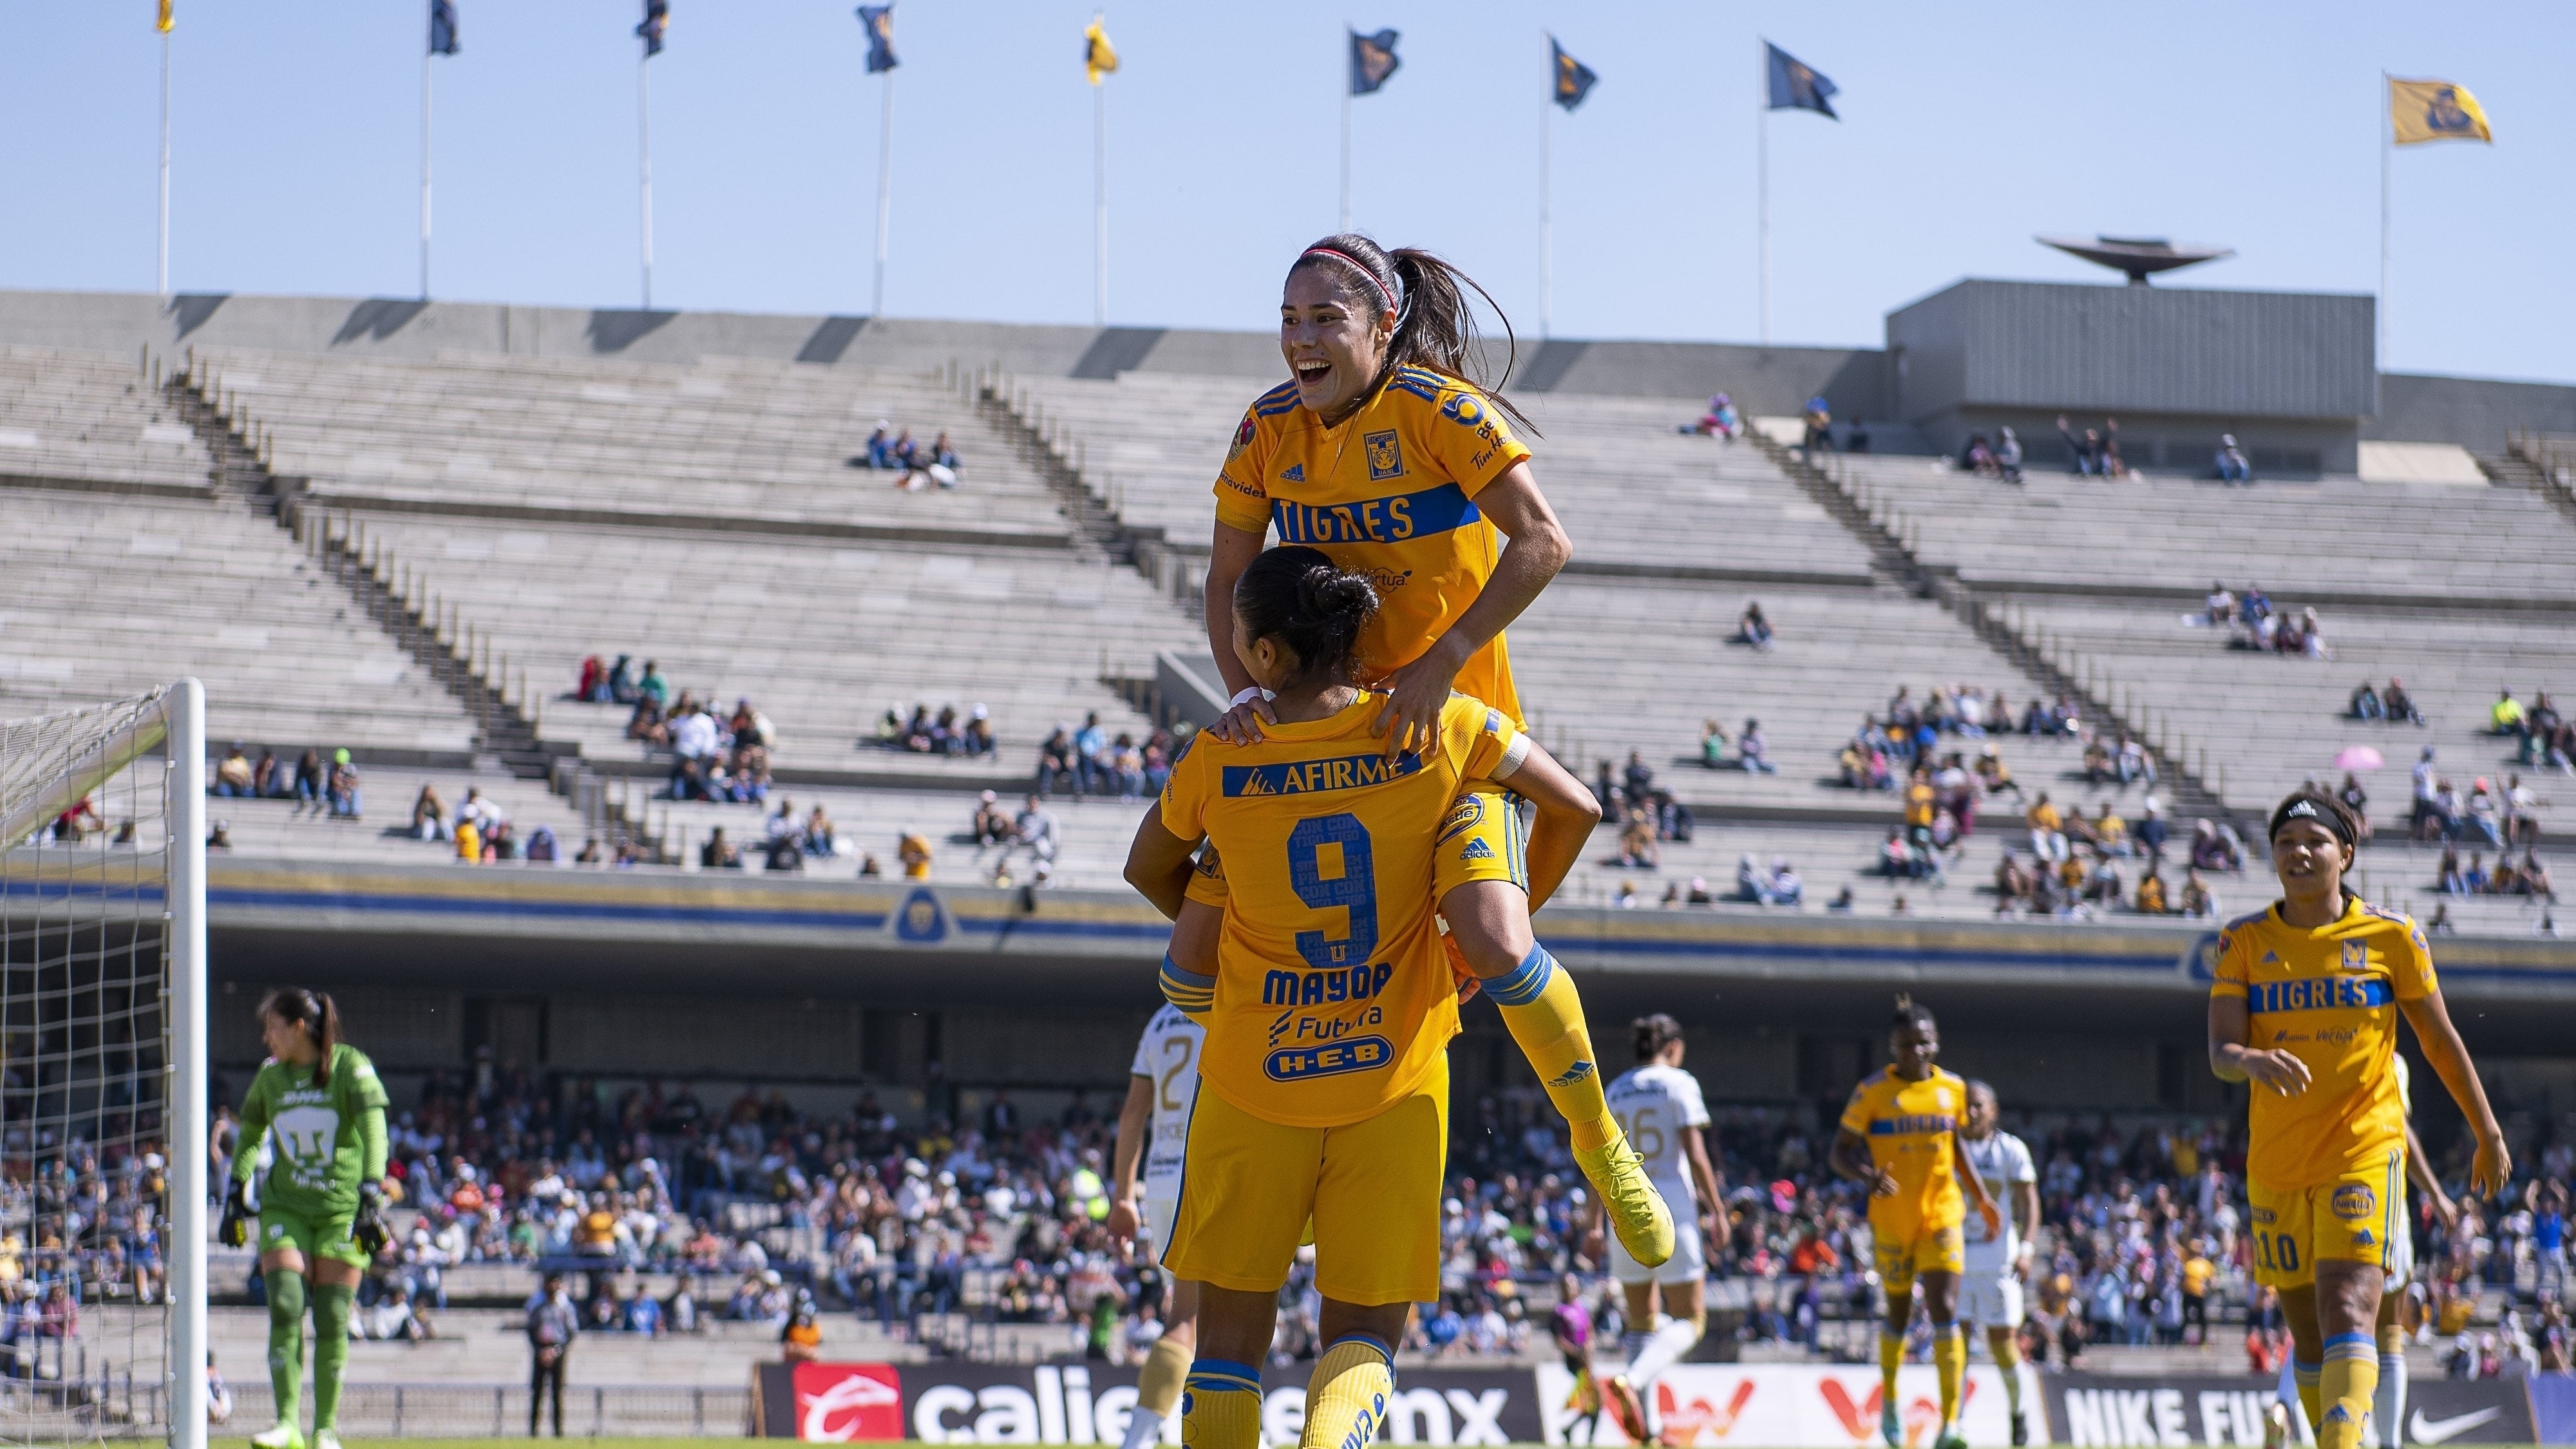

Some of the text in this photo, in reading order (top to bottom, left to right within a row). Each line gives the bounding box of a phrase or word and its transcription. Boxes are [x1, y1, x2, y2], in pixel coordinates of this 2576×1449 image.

[1368, 433, 1394, 443] TIGRES
[1280, 471, 1306, 482] adidas
[1470, 450, 1493, 470] Tim
[1280, 497, 1414, 542] TIGRES
[1283, 757, 1404, 793] AFIRME
[1286, 812, 1379, 969] 9
[2260, 978, 2367, 1011] TIGRES
[1162, 1036, 1193, 1111] 2
[1278, 1043, 1379, 1073] H-E-B
[913, 1365, 1510, 1445] calieemx
[2064, 1387, 2190, 1448] NIKE
